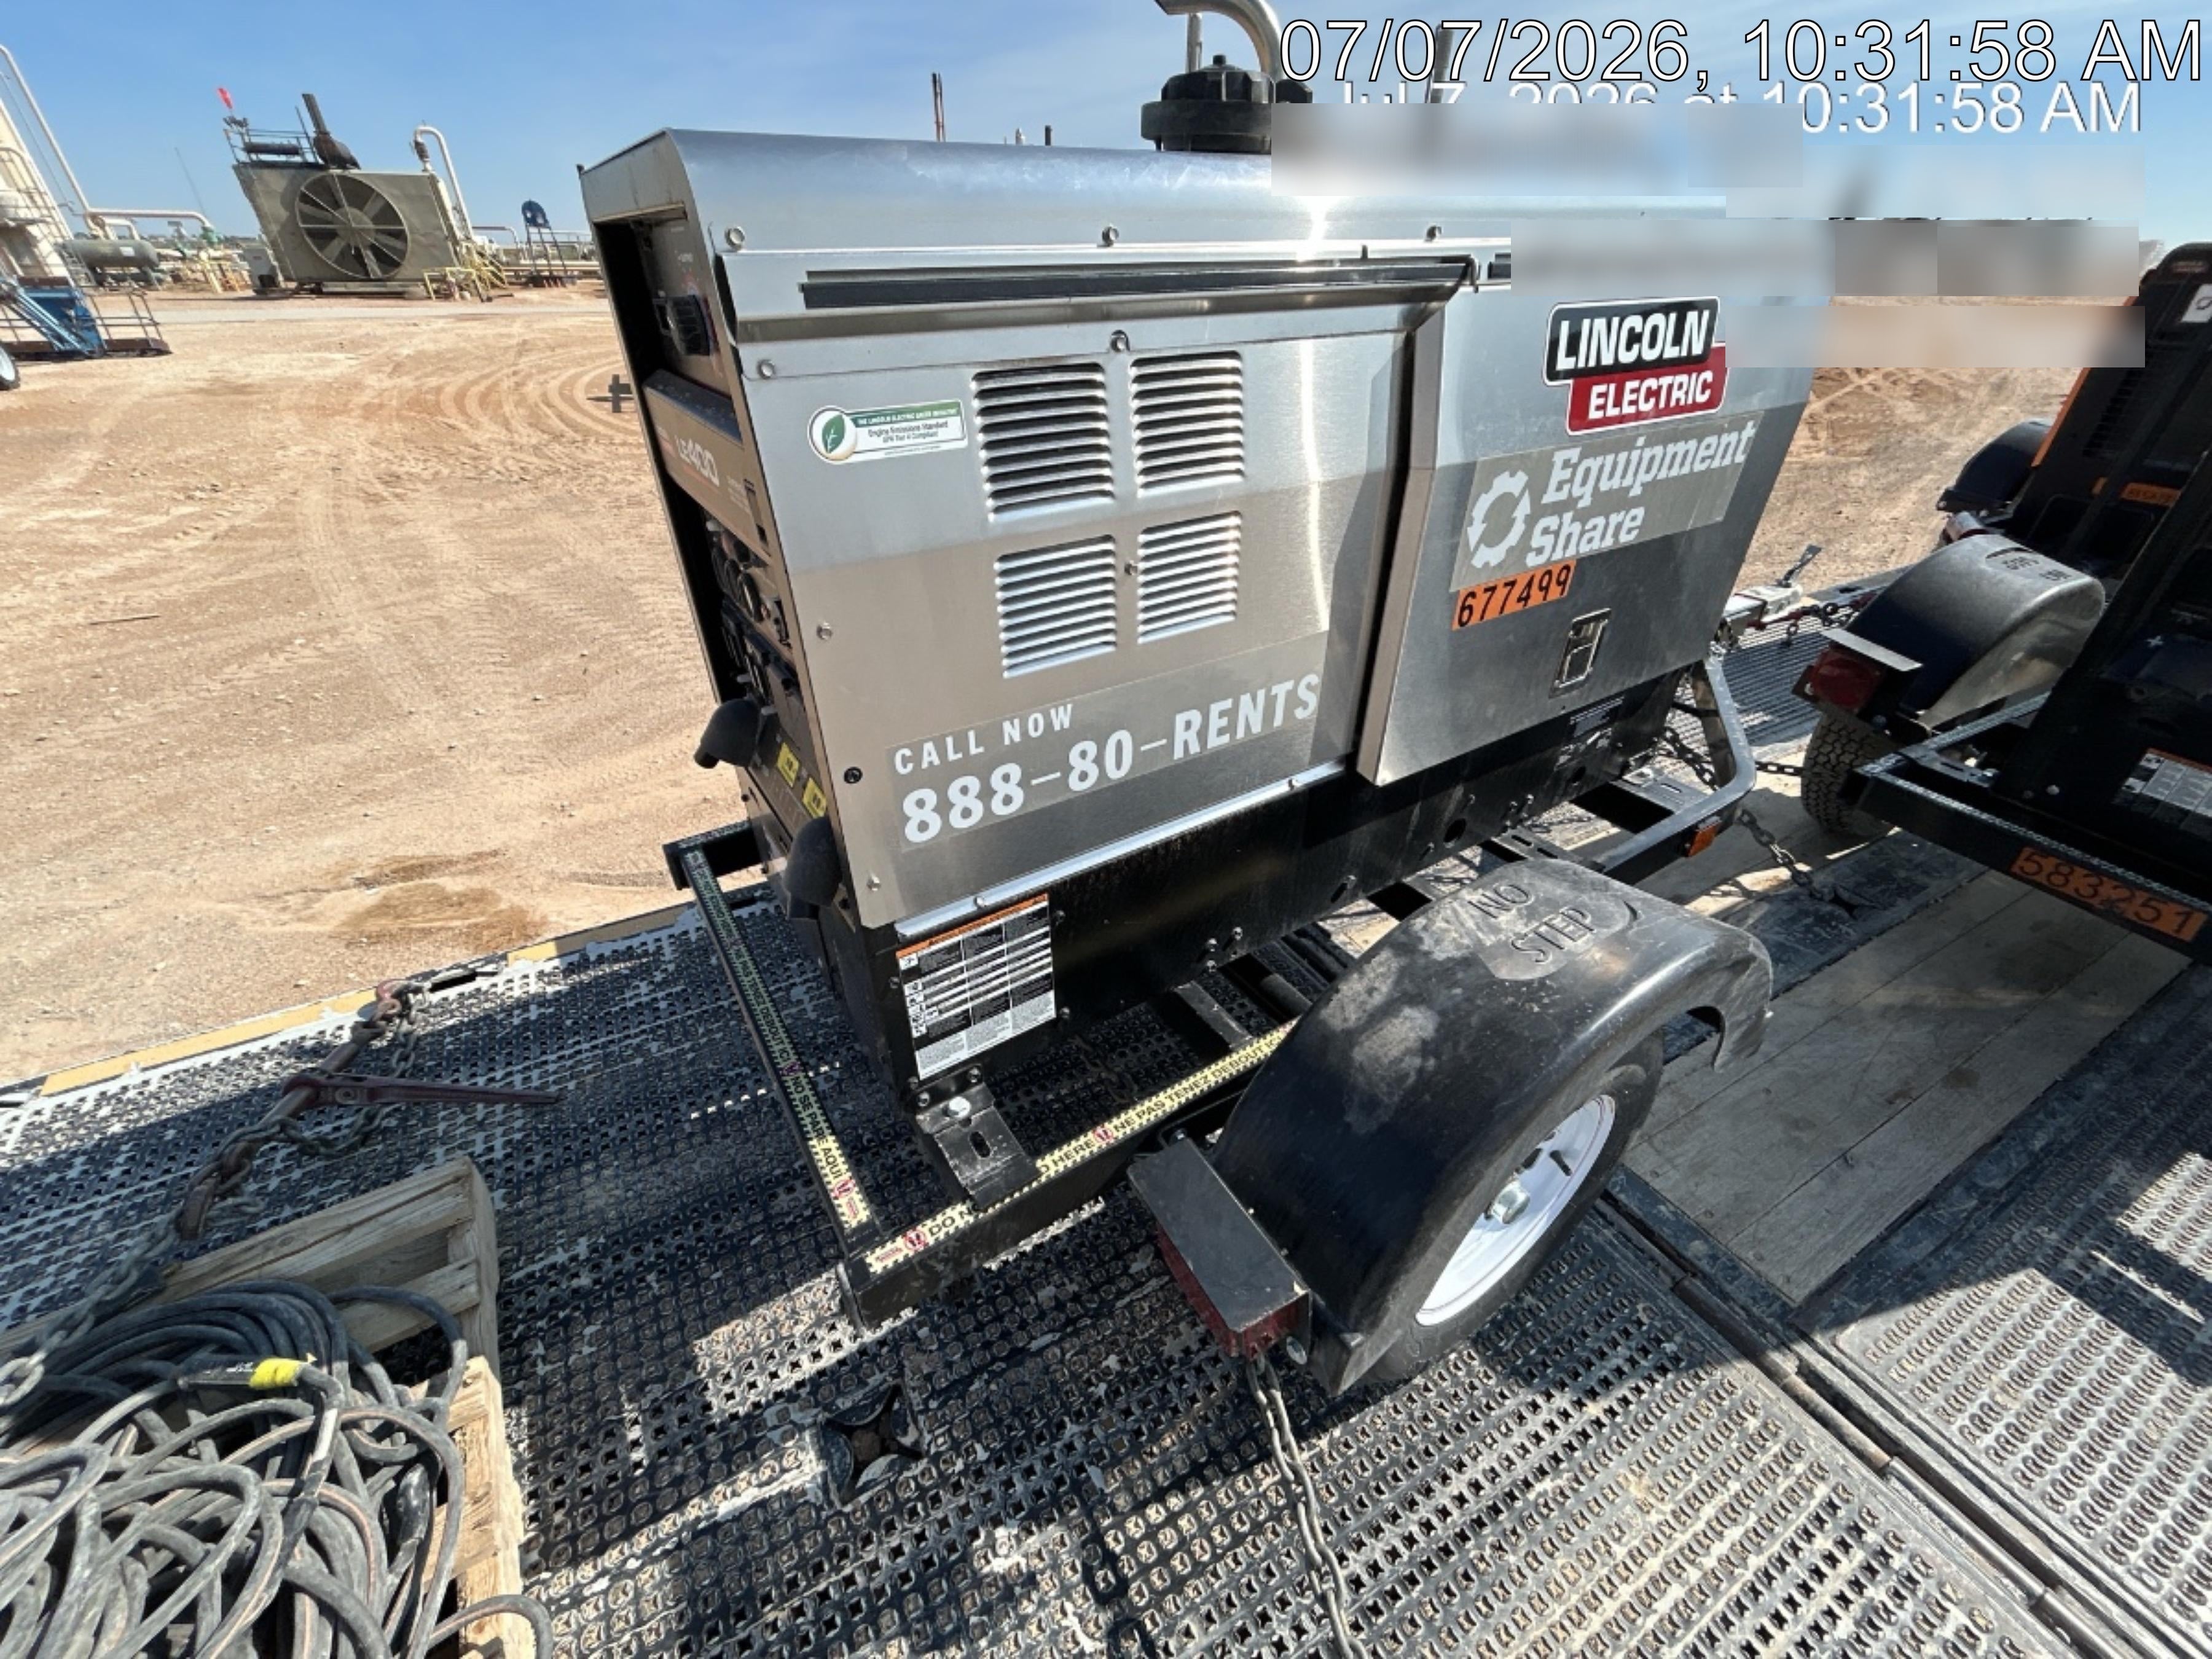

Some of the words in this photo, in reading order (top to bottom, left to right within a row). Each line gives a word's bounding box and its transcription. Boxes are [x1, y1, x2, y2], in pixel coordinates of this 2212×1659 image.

[1556, 309, 1709, 371] LINCOLN
[1588, 369, 1714, 420] ELECTRIC
[1541, 420, 1757, 508] Equipment
[1525, 506, 1645, 567] Share
[1457, 564, 1572, 627] 677499
[893, 730, 985, 775] CALL
[1002, 703, 1074, 745] NOW
[902, 673, 1320, 844] 888-80-RENTS
[1467, 882, 1534, 920] NO
[2019, 851, 2193, 933] 583251
[1511, 904, 1598, 964] STEP
[798, 1095, 813, 1110] SE
[806, 1112, 829, 1147] PARE
[1051, 1138, 1096, 1165] HERE
[928, 1215, 955, 1236] DO
